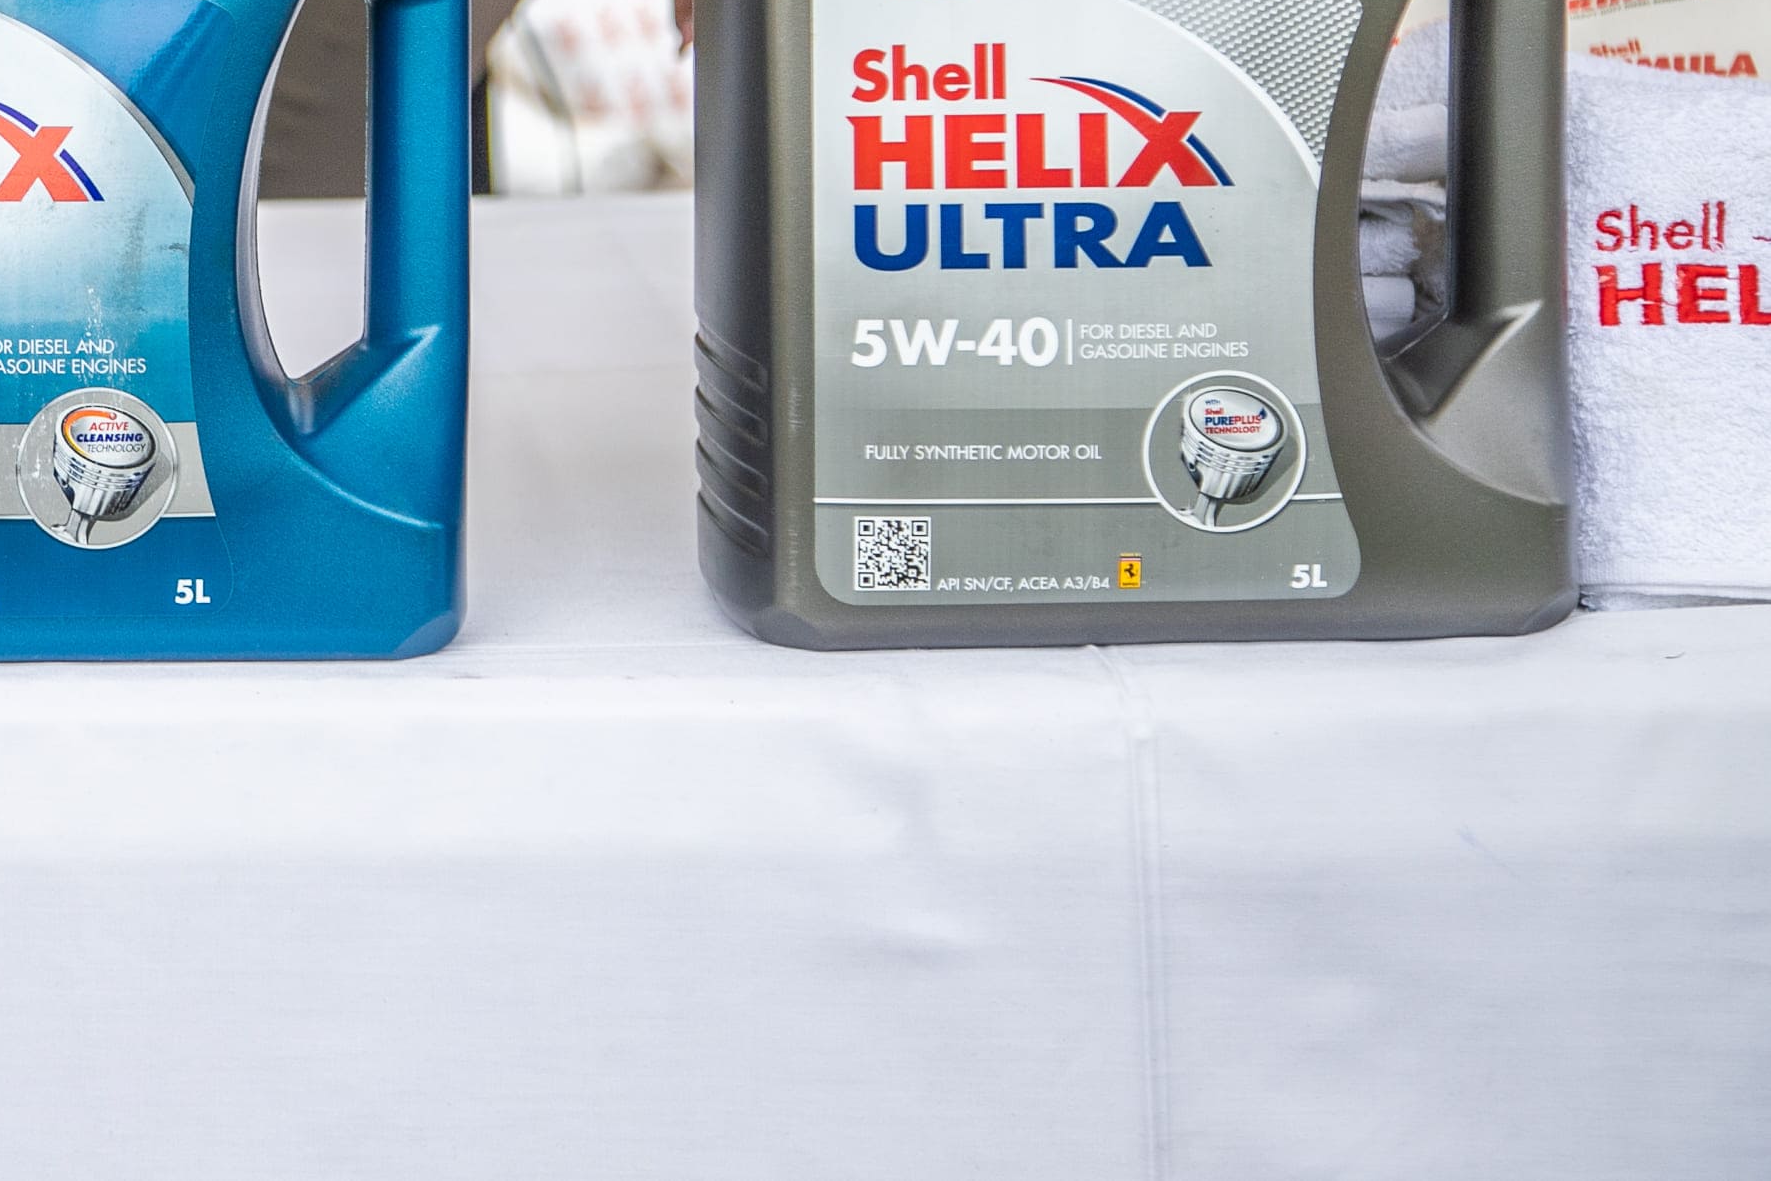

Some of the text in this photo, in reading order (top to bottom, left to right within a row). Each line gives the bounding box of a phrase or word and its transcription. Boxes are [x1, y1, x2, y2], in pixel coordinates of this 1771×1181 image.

[851, 42, 1007, 103] Shell
[845, 75, 1236, 191] HELIX
[1595, 200, 1726, 252] Shell
[853, 201, 1213, 272] ULTRA
[1079, 322, 1217, 340] FOR DIESEL AND
[19, 339, 71, 355] DIESEL
[75, 339, 114, 355] AND
[850, 317, 1059, 368] 5W-40
[1079, 341, 1249, 359] GASOLINE ENGINES
[71, 358, 146, 375] ENGINES
[89, 422, 129, 431] ACTIVE
[1204, 415, 1261, 426] PUREPLUS
[76, 433, 143, 442] CLEANSING
[1204, 426, 1261, 434] TECHNOLOGY
[87, 444, 146, 453] TECHNOLOGY
[865, 444, 1102, 461] FULLY SYNTHETIC MOTOR OIL
[937, 576, 1110, 594] API SN/CF, ACEA A3/B4
[1291, 564, 1328, 589] 5L
[174, 579, 211, 605] 5L
